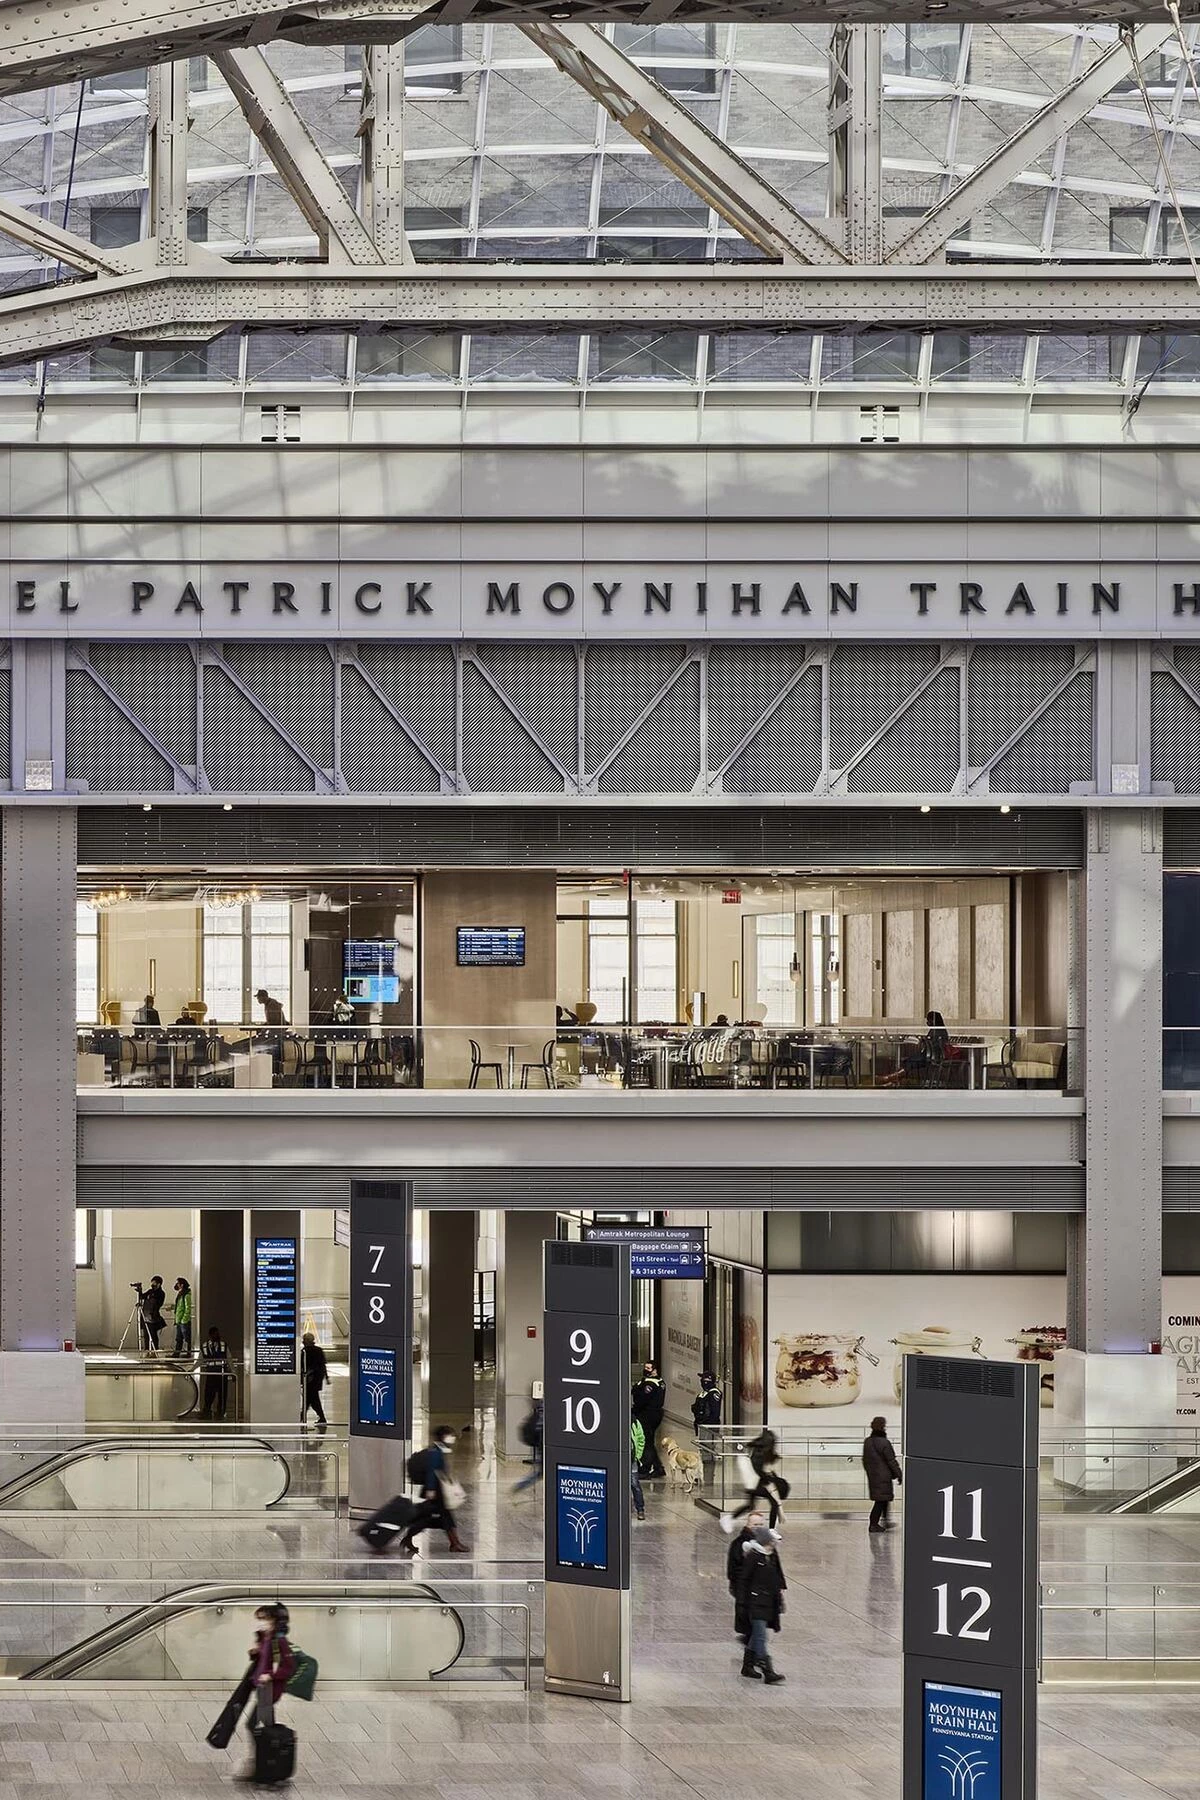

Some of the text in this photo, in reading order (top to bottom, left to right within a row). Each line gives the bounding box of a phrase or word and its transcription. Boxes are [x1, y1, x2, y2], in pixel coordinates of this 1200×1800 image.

[131, 582, 435, 613] PATRICK
[486, 582, 858, 615] MOYNIHAN
[909, 582, 1122, 615] TRAIN
[625, 1231, 665, 1239] Metropolitan
[666, 1231, 690, 1239] Lounge
[631, 1243, 659, 1251] Baggage
[366, 1245, 385, 1273] 7
[368, 1296, 386, 1324] 8
[569, 1330, 592, 1366] 9
[361, 1358, 394, 1366] MOYNIHAN
[562, 1397, 601, 1434] 10
[560, 1478, 604, 1490] MOYNIHAN
[560, 1486, 605, 1498] TRAIN HALL
[937, 1485, 987, 1542] 11
[932, 1583, 992, 1641] 12
[929, 1702, 997, 1722] MOYNIHAN
[928, 1713, 999, 1734] TRAIN HALL
[932, 1727, 994, 1742] PENNSYLVANIA STATION
